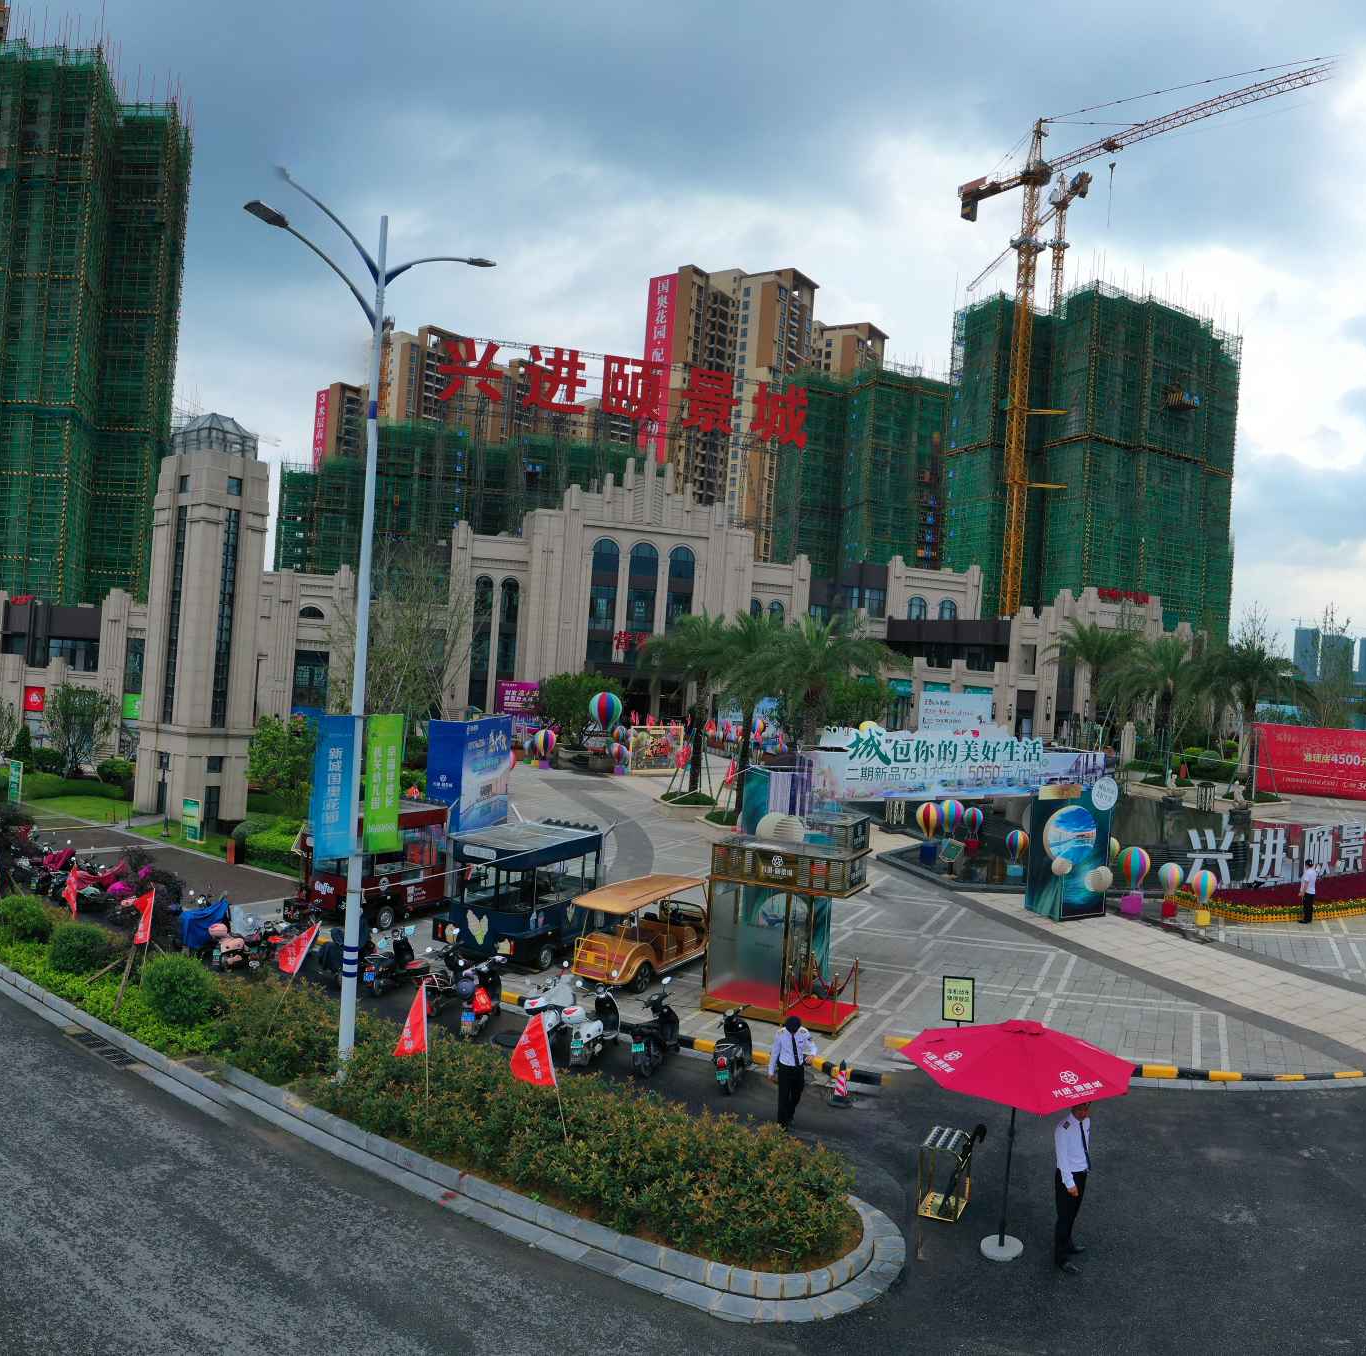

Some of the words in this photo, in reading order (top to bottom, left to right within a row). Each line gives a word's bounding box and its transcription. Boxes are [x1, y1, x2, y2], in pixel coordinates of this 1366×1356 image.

[438, 338, 808, 449] 兴进颐景城
